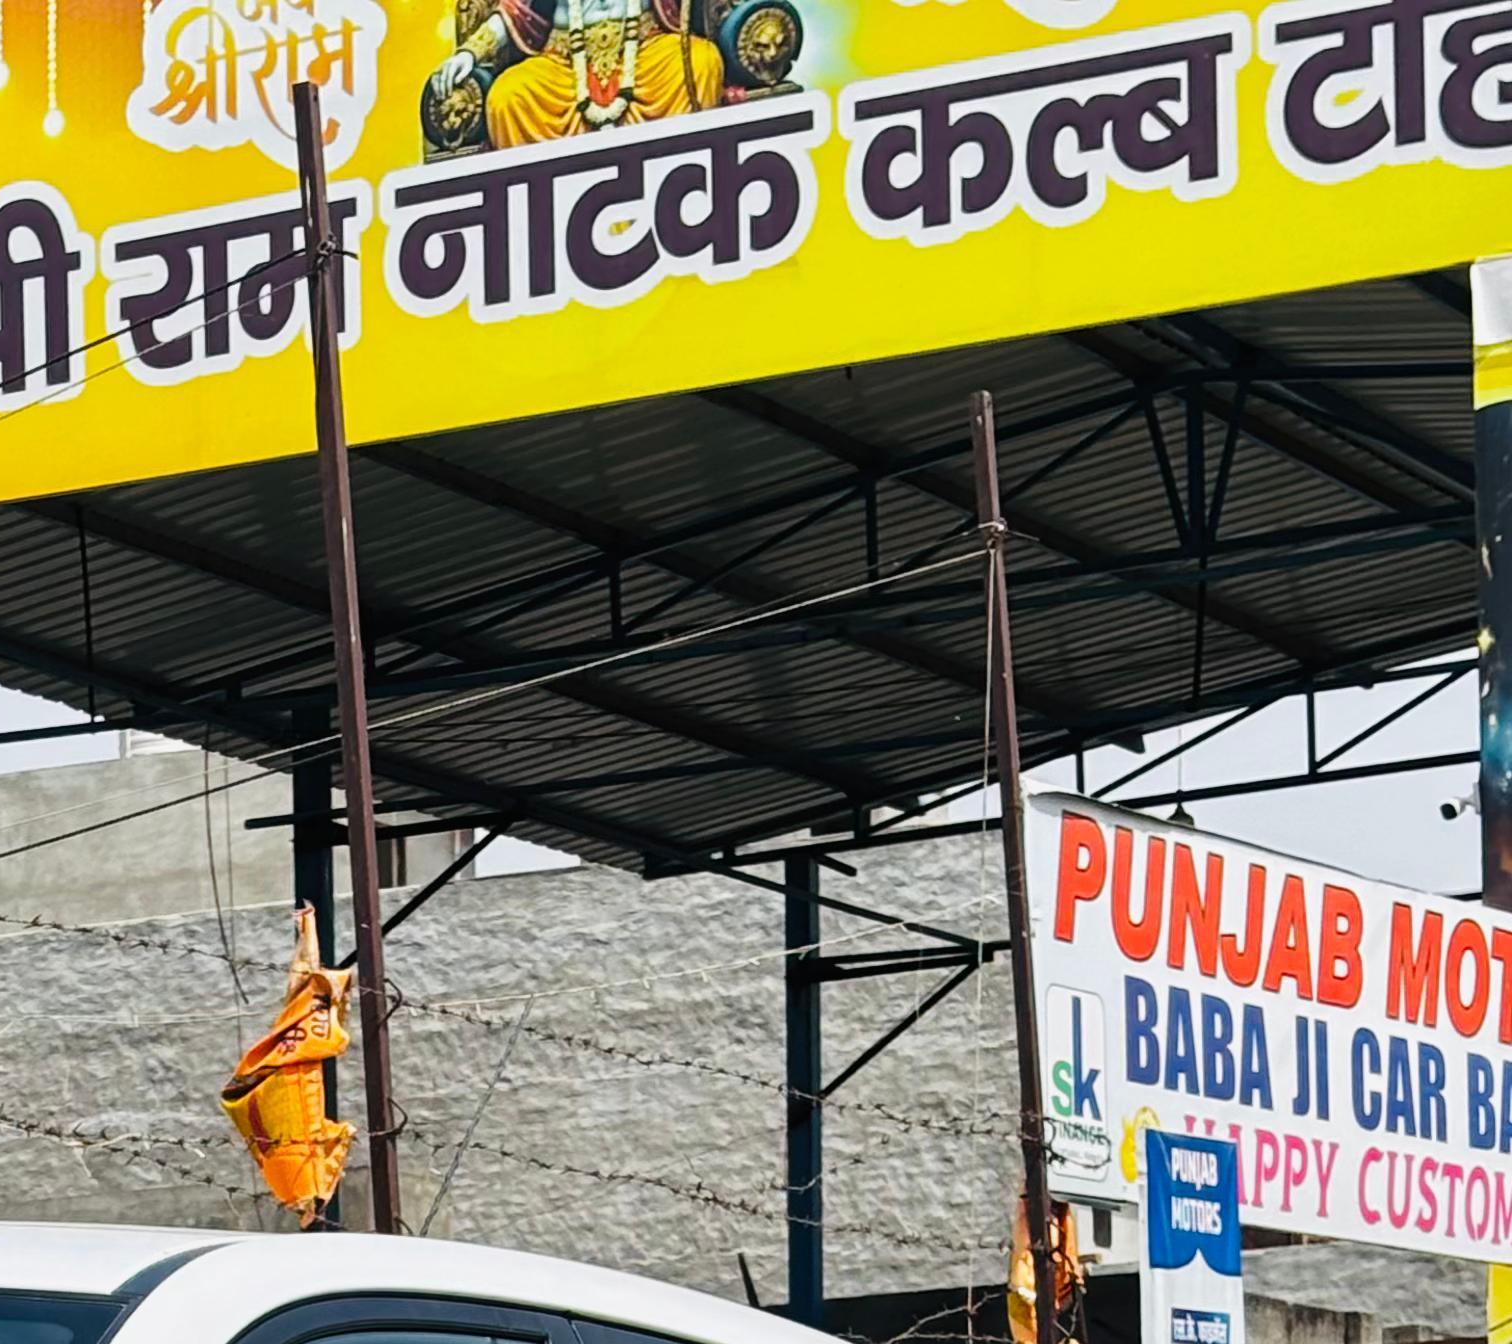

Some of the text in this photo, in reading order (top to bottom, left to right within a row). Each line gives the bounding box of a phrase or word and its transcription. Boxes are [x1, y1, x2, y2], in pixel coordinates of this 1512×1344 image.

[114, 198, 359, 370] राम
[394, 111, 816, 307] नाटक
[1053, 810, 1363, 1008] PUNJAB
[1124, 975, 1274, 1112] BABA
[1292, 1015, 1330, 1121] JI
[1351, 1027, 1448, 1143] CAR
[1170, 1147, 1219, 1191] PUNJAB
[1170, 1195, 1223, 1235] MOTORS
[1184, 1114, 1340, 1218] APPY
